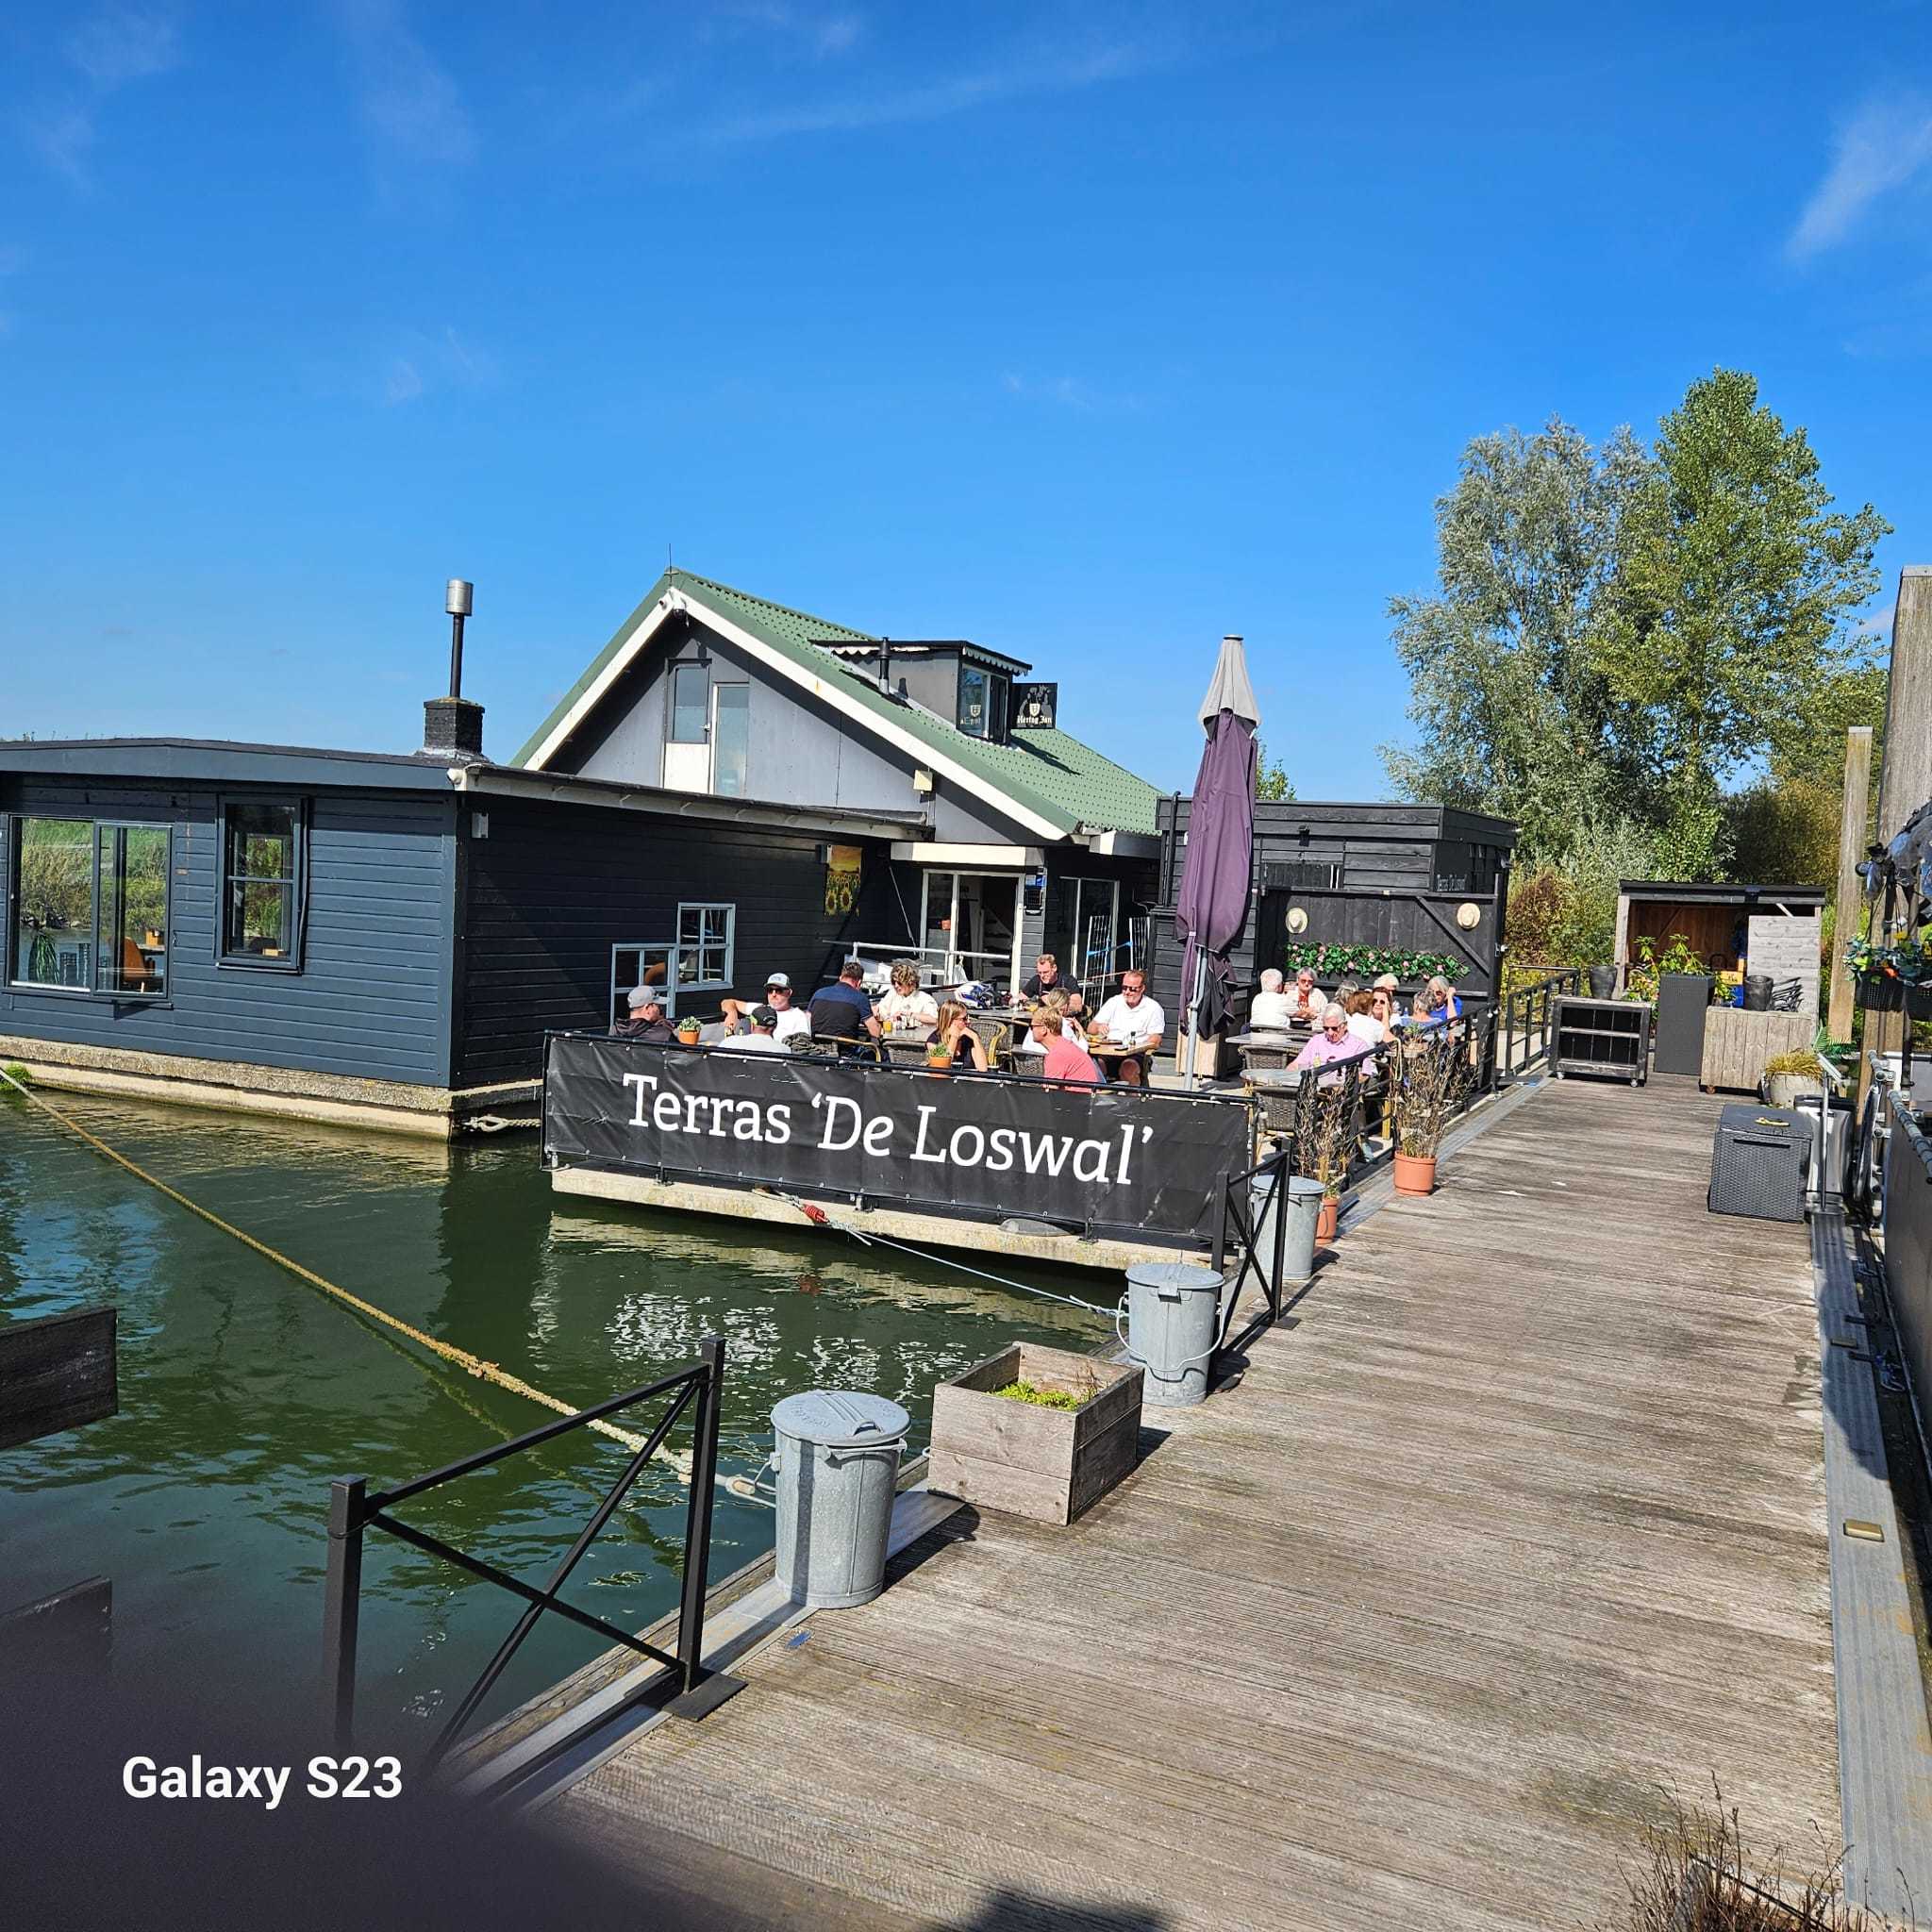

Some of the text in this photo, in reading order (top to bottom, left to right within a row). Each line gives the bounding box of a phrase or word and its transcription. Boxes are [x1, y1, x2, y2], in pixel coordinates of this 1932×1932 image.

[623, 1072, 1154, 1186] Terras ‘De Loswal’
